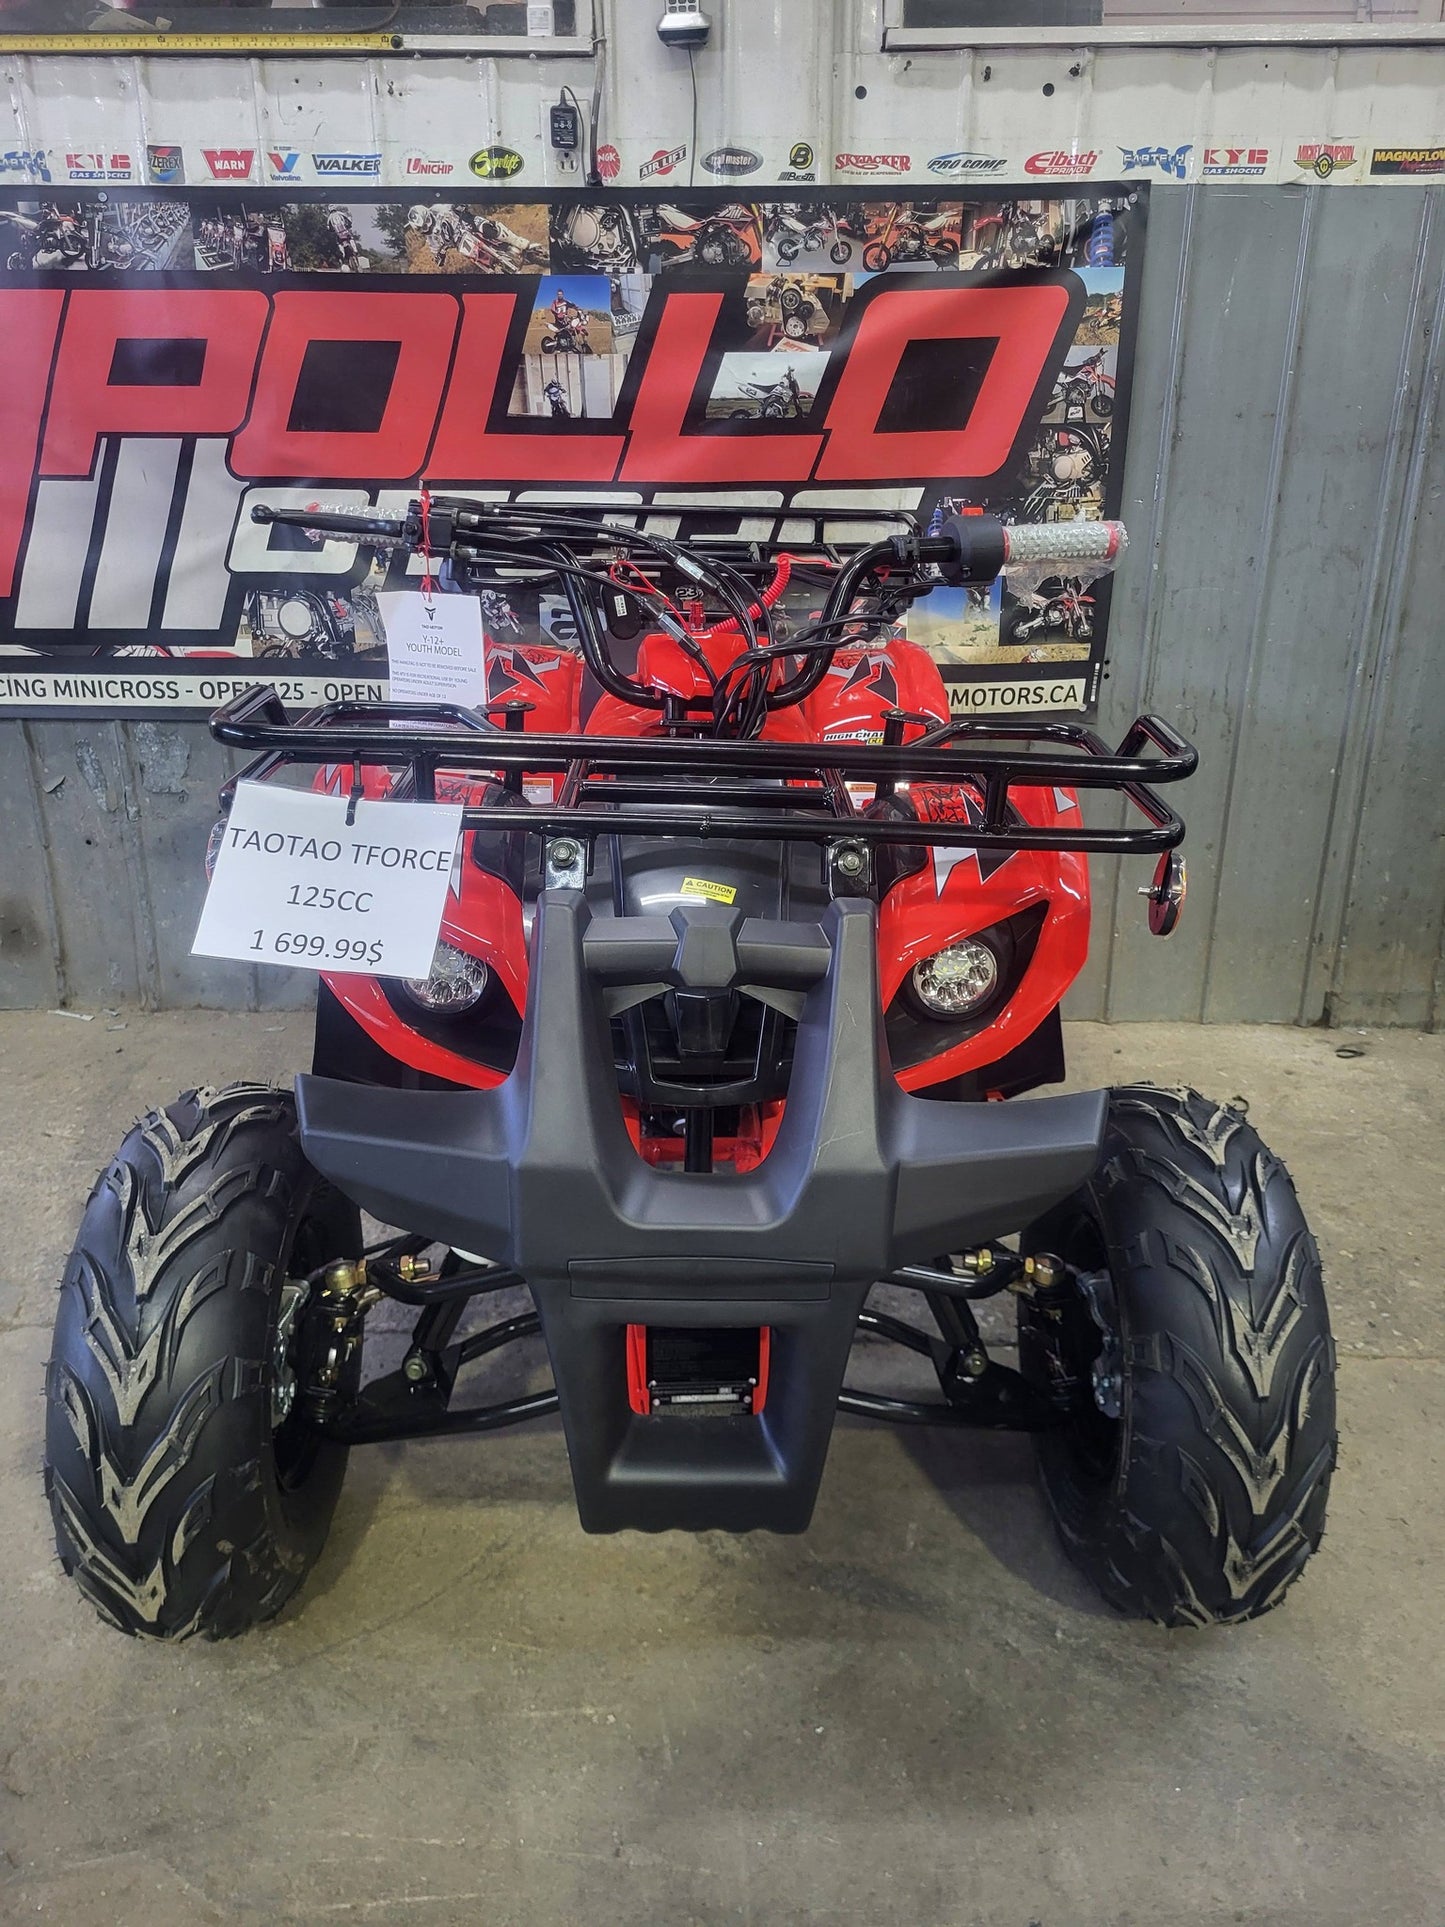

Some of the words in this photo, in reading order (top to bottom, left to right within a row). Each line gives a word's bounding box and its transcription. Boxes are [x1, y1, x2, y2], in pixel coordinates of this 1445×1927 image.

[151, 155, 181, 169] ZEREX
[311, 154, 381, 172] WALKER
[598, 153, 616, 162] NGK
[640, 161, 662, 177] AIR
[664, 149, 686, 167] LIFT
[725, 155, 752, 166] master
[835, 154, 911, 171] SKYJACKER
[1024, 150, 1098, 174] Eibach
[1203, 149, 1269, 164] KYB
[214, 159, 246, 170] WARN
[406, 158, 454, 175] UNICHIP
[928, 159, 961, 169] PRO
[961, 159, 1008, 170] COMP
[1044, 166, 1088, 174] SPRINGS
[1224, 167, 1264, 175] SHOCKS
[92, 171, 130, 179] SHOCKS
[423, 635, 444, 645] Y-12+
[406, 643, 432, 654] YOUTH
[434, 645, 462, 657] MODEL
[53, 680, 179, 699] MINICROSS
[200, 681, 259, 700] OPE
[324, 683, 382, 702] OPEN
[946, 685, 1078, 707] MOTORS.CA
[230, 827, 342, 862] TAOTAO
[351, 842, 451, 873] TFORCE
[696, 881, 732, 895] CAUTION
[286, 884, 374, 914] 125CC
[249, 928, 264, 951] 1
[274, 931, 385, 967] 699.99$
